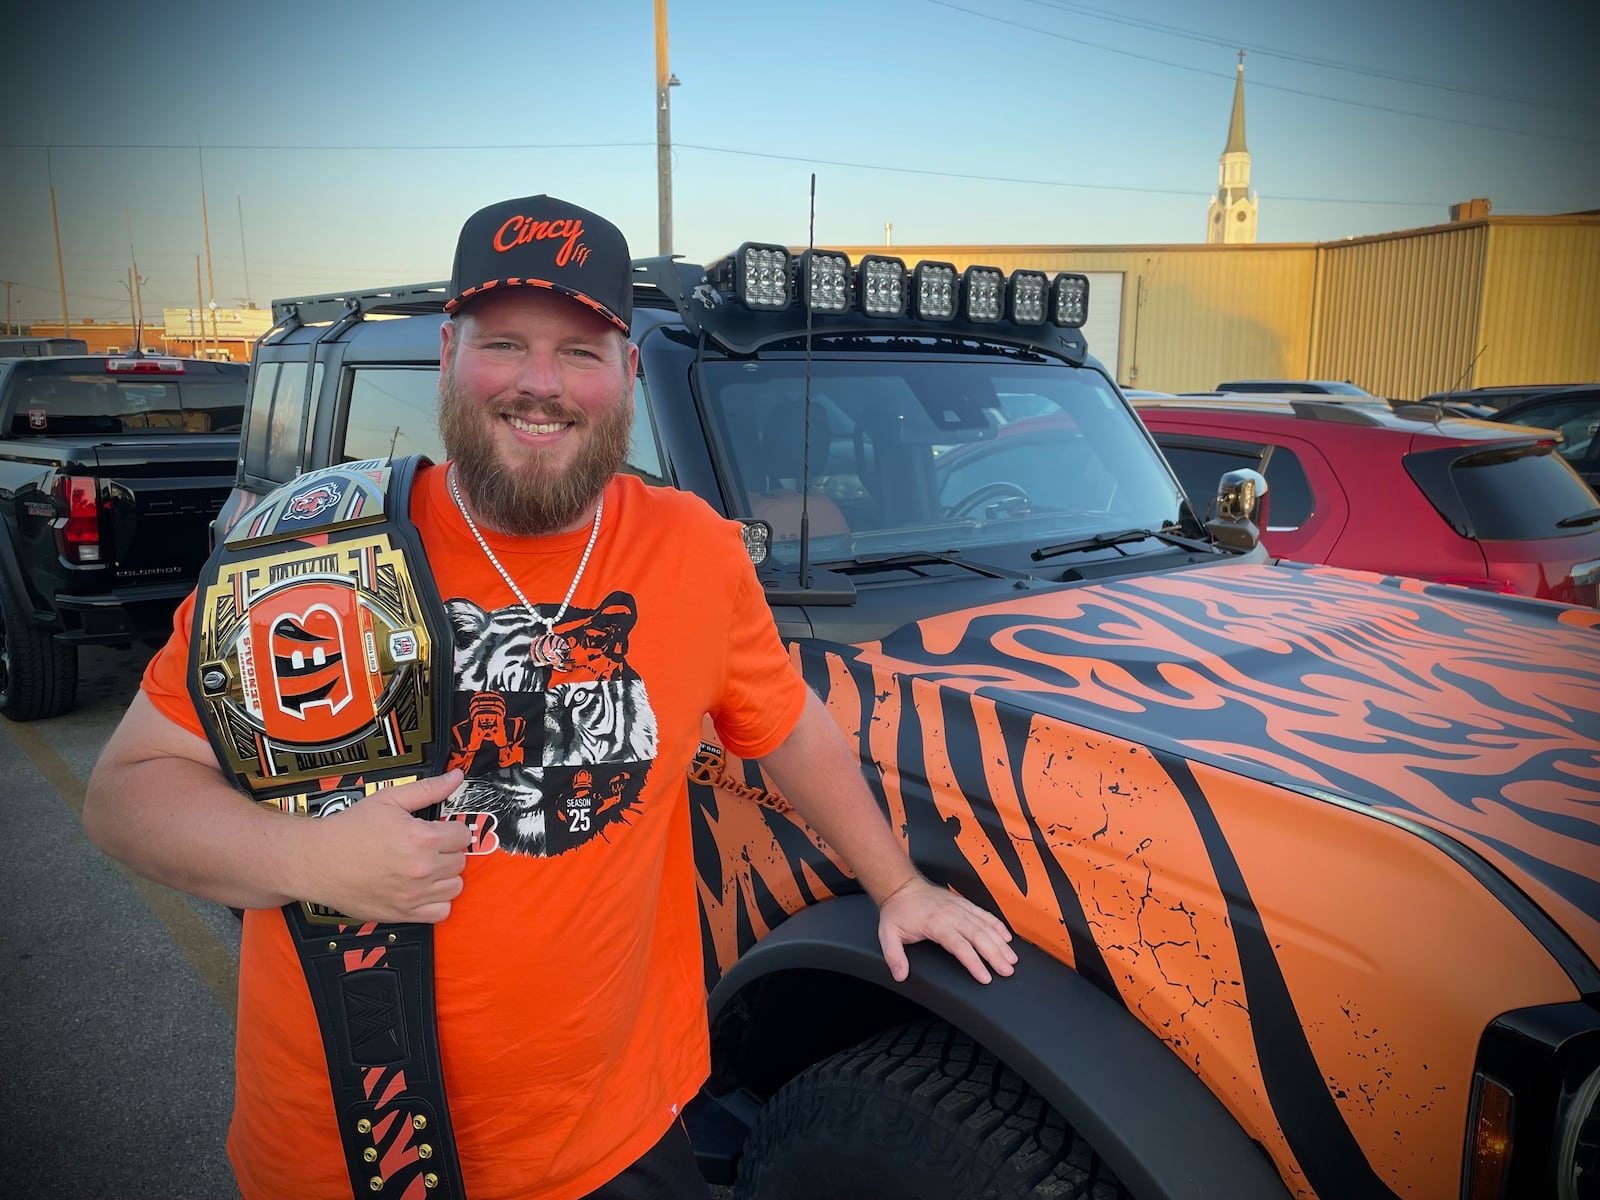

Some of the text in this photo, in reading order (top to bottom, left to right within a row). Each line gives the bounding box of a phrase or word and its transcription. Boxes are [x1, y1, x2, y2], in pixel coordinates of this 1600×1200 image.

[493, 214, 584, 268] Cincy
[243, 637, 261, 711] BENGALS
[566, 797, 591, 808] SEASON
[687, 752, 793, 814] Bronco
